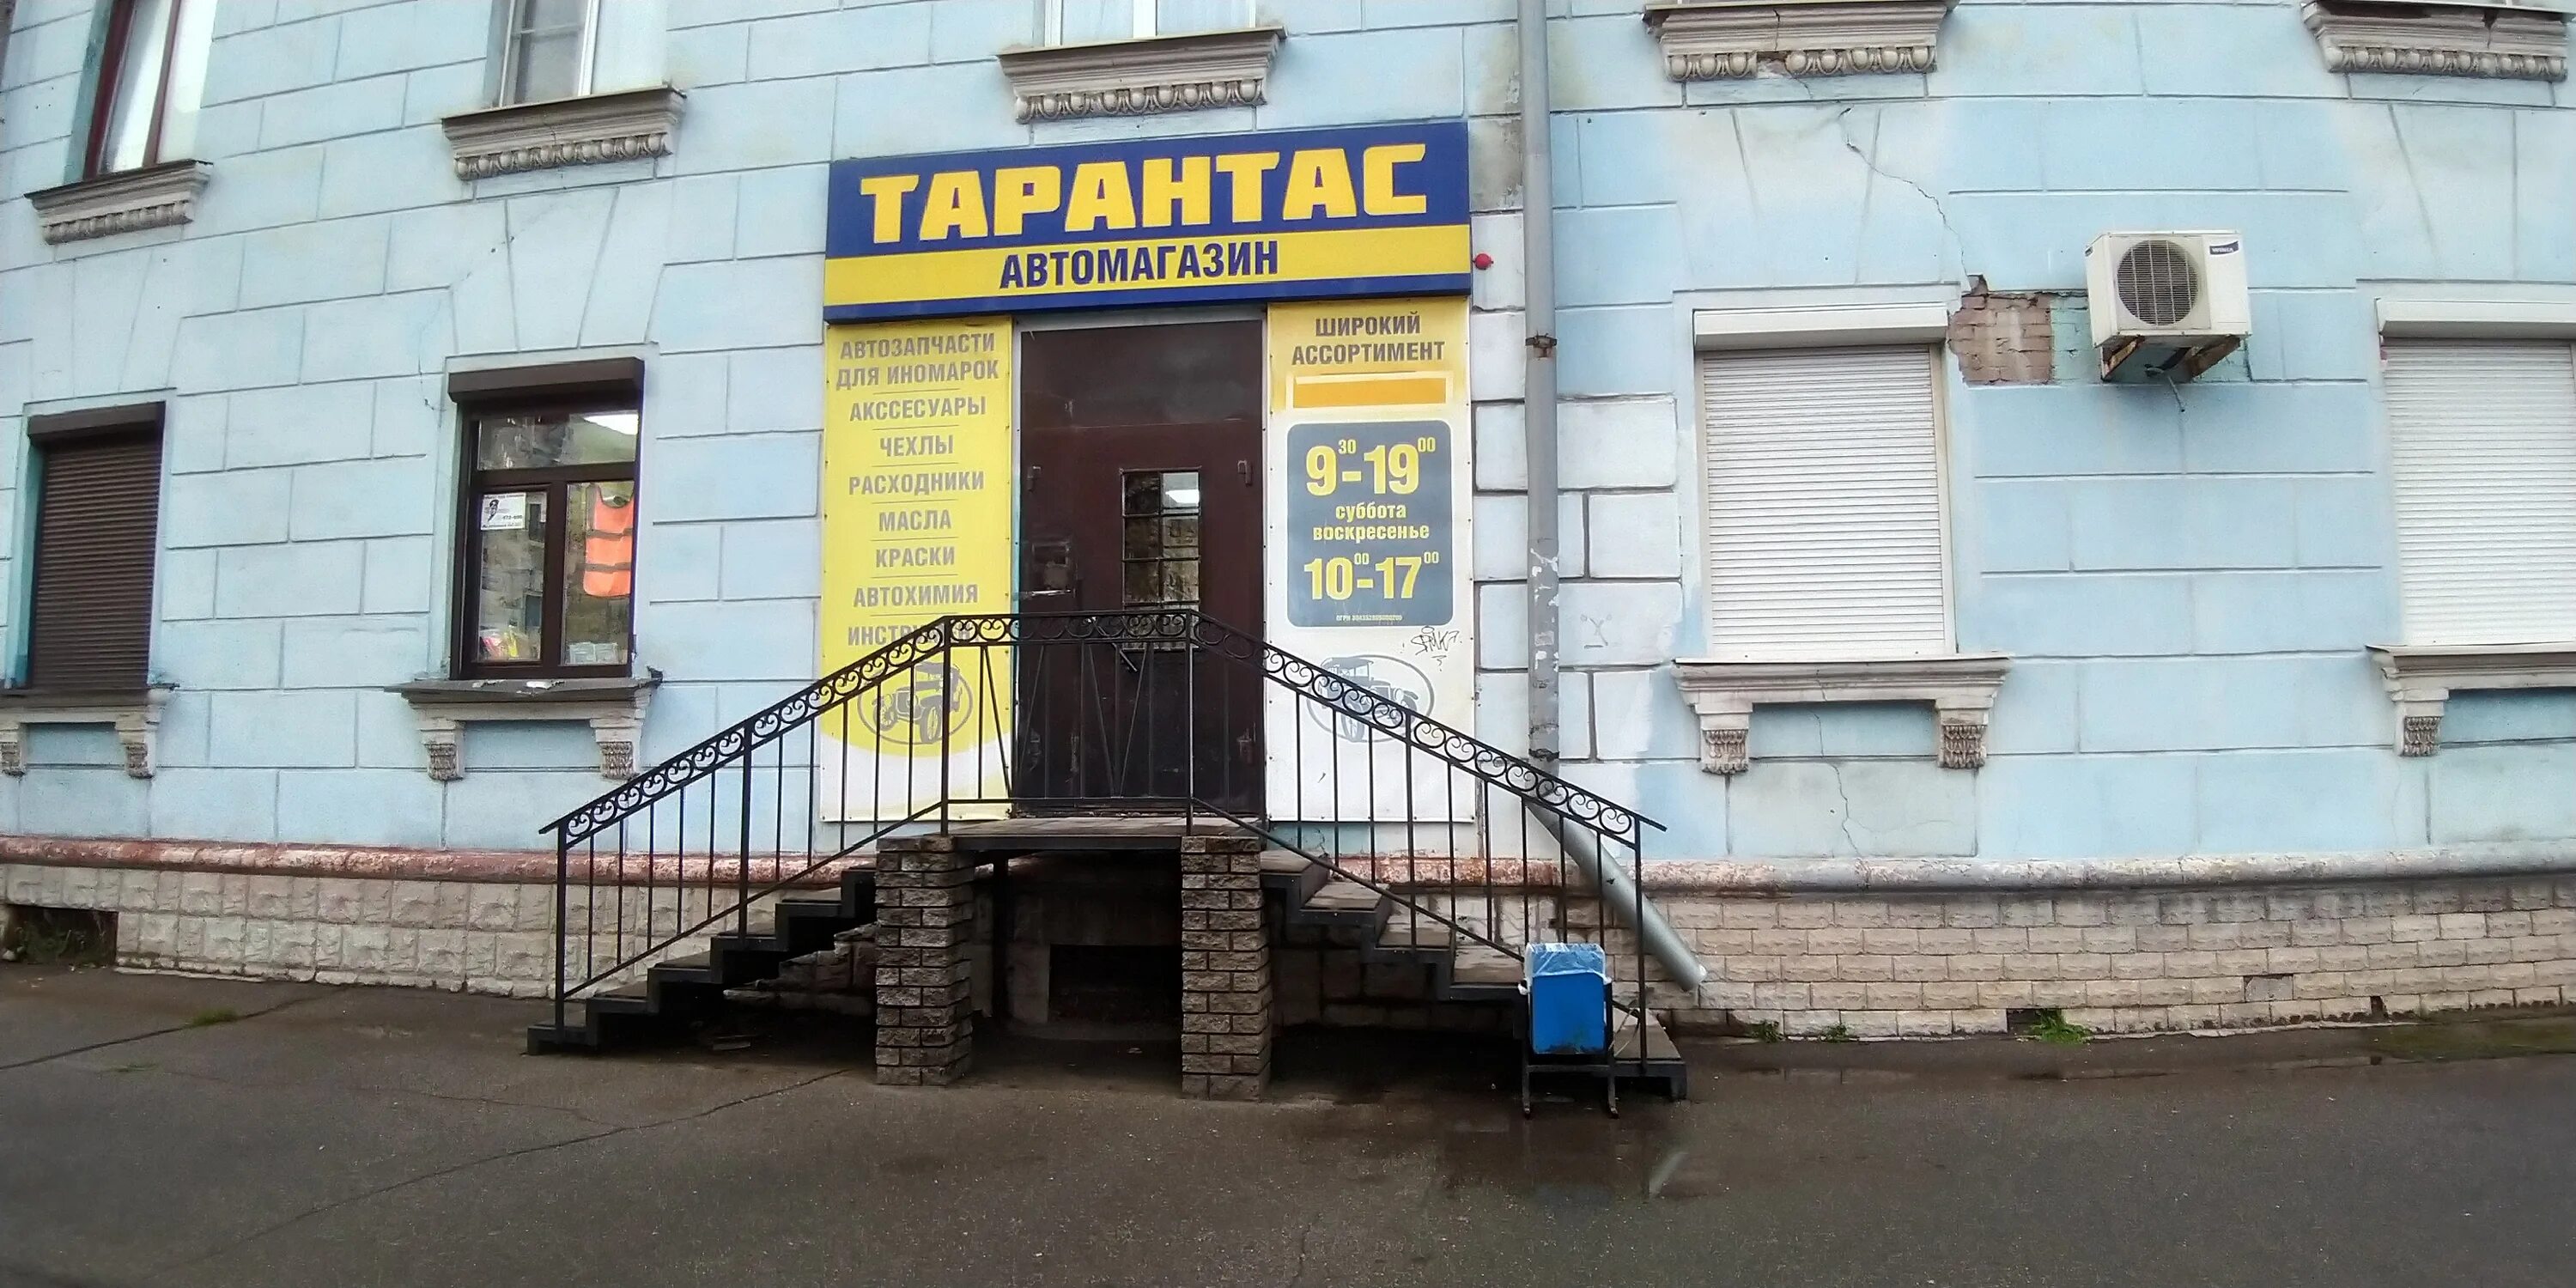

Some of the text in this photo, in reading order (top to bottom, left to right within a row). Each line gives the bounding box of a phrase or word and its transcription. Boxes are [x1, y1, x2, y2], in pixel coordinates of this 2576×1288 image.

[860, 143, 1427, 244] ТАРАНТАС
[999, 240, 1279, 290] АВТОМАГАЗИН
[1315, 311, 1421, 337] ШИРОКИЙ
[840, 332, 996, 361] АВТОЗАПЧАСТИ
[1291, 341, 1446, 366] АССОРТИМЕНТ
[835, 359, 1000, 391] ДЛЯ ИНОМАРОК
[849, 396, 987, 422] АКССЕСУАРЫ
[879, 434, 954, 457] ЧЕХЛЫ
[848, 471, 985, 496] РАСХОДНИКИ
[878, 509, 952, 532] МАСЛА
[1334, 501, 1407, 523] суббота
[1312, 525, 1431, 544] воскресенье
[875, 546, 956, 568] КРАСКИ
[853, 584, 979, 608] АВТОХИМИЯ
